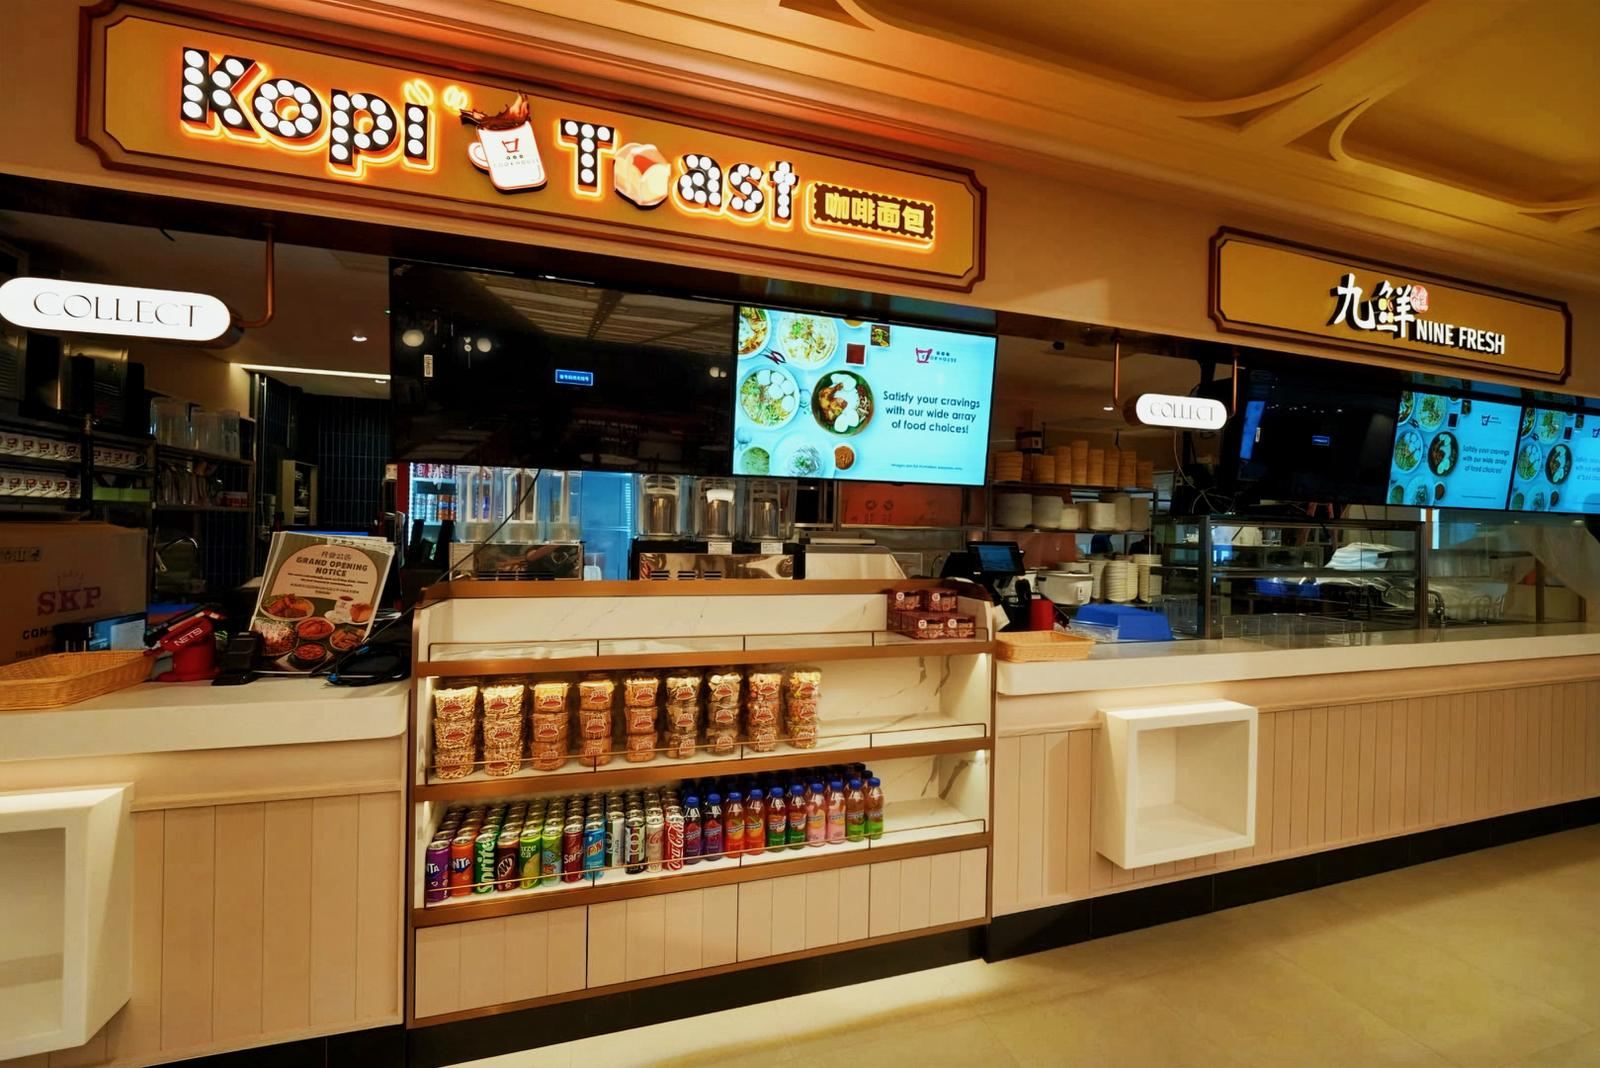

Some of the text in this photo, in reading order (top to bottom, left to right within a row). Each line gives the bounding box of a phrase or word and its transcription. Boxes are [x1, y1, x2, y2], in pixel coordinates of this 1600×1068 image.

[181, 46, 432, 170] Kopi
[824, 191, 926, 235] 咖啡面包
[33, 291, 204, 328] COLLECT
[1330, 272, 1417, 339] 九鲜
[1416, 318, 1506, 355] NINE FRESH
[883, 390, 980, 410] Satisfy your cravings
[885, 405, 977, 423] with our wide array
[891, 419, 969, 434] of food choices!
[296, 556, 368, 572] GRAND OPENING
[315, 567, 347, 577] NOTICE
[37, 586, 102, 617] SKP
[174, 627, 203, 647] NETS
[476, 838, 496, 894] Sprite
